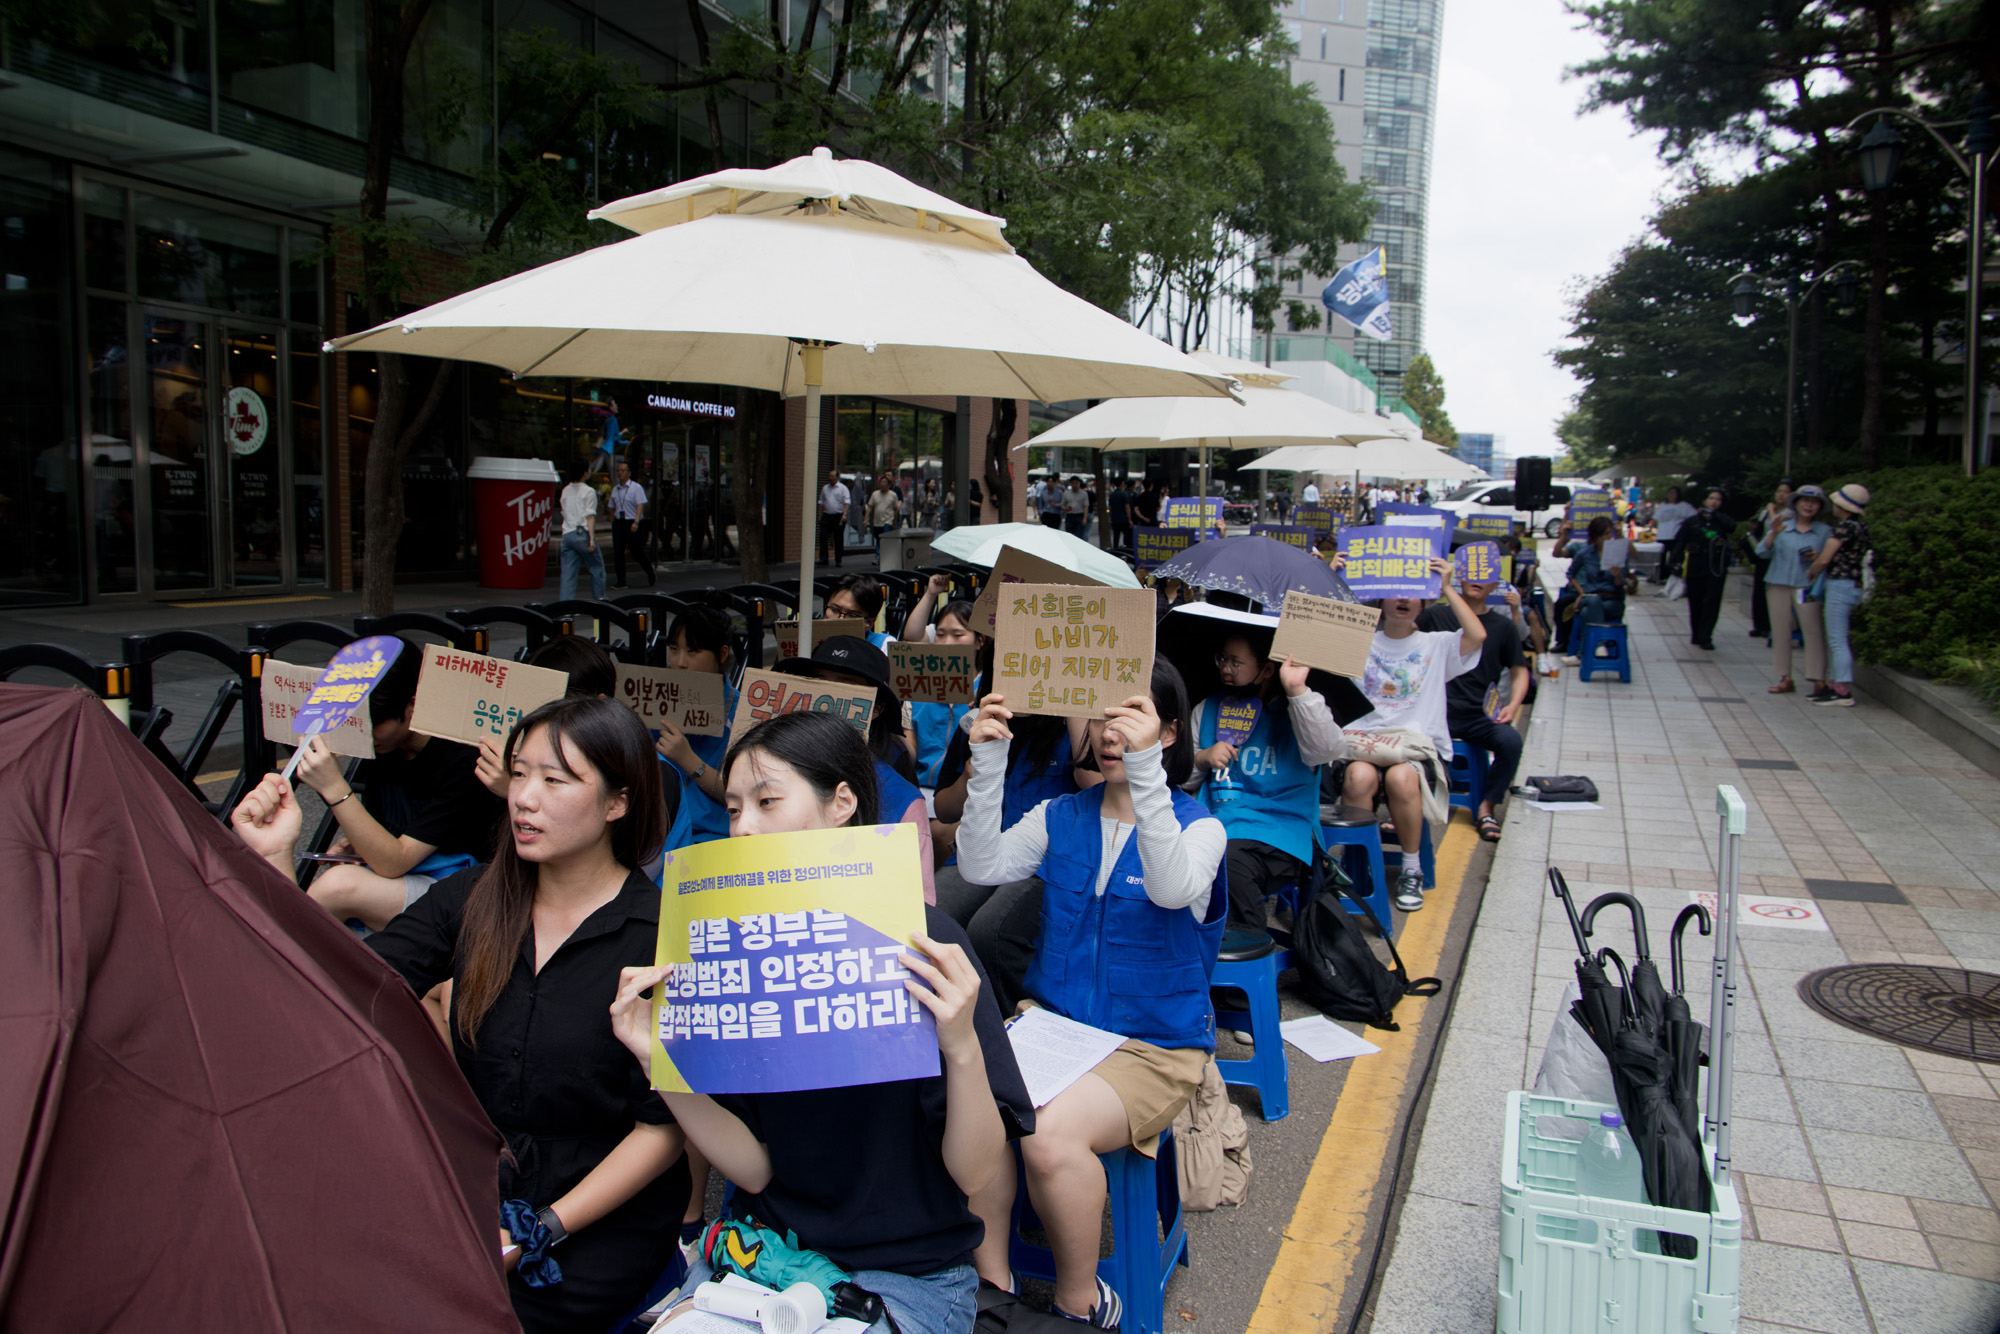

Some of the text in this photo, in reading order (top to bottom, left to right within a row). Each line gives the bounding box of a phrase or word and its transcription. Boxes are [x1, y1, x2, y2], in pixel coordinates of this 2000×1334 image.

[647, 394, 736, 418] CANADIAN COFFEE HO
[230, 414, 258, 433] Tims
[165, 470, 197, 479] K-TWIN
[506, 489, 551, 527] Tim
[1137, 533, 1189, 548] 공식사죄!
[1348, 537, 1431, 558] 공식사죄!
[1345, 559, 1431, 579] 법적배상!
[1012, 593, 1106, 625] 저희들이
[777, 622, 799, 630] YWC
[1035, 625, 1119, 649] 나비가
[323, 659, 387, 683] 공식사죄
[435, 655, 509, 689] 피해자분들
[892, 654, 971, 676] 기억하자
[1001, 653, 1051, 680] 되어
[274, 675, 296, 693] 역사는
[307, 682, 370, 705] 법적배상
[895, 675, 970, 701] 잊지말자
[1028, 680, 1098, 709] 습니다
[269, 702, 287, 719] 일본군
[1221, 706, 1256, 719] 공식사죄
[1218, 718, 1253, 731] 법적배상
[678, 862, 874, 896] 일본군성노예제 문제해결을 위한 정의기억연대
[688, 908, 848, 955] 일본 정부는
[760, 945, 912, 994] 인정하고
[658, 987, 922, 1041] 법적책임을 다하라!
